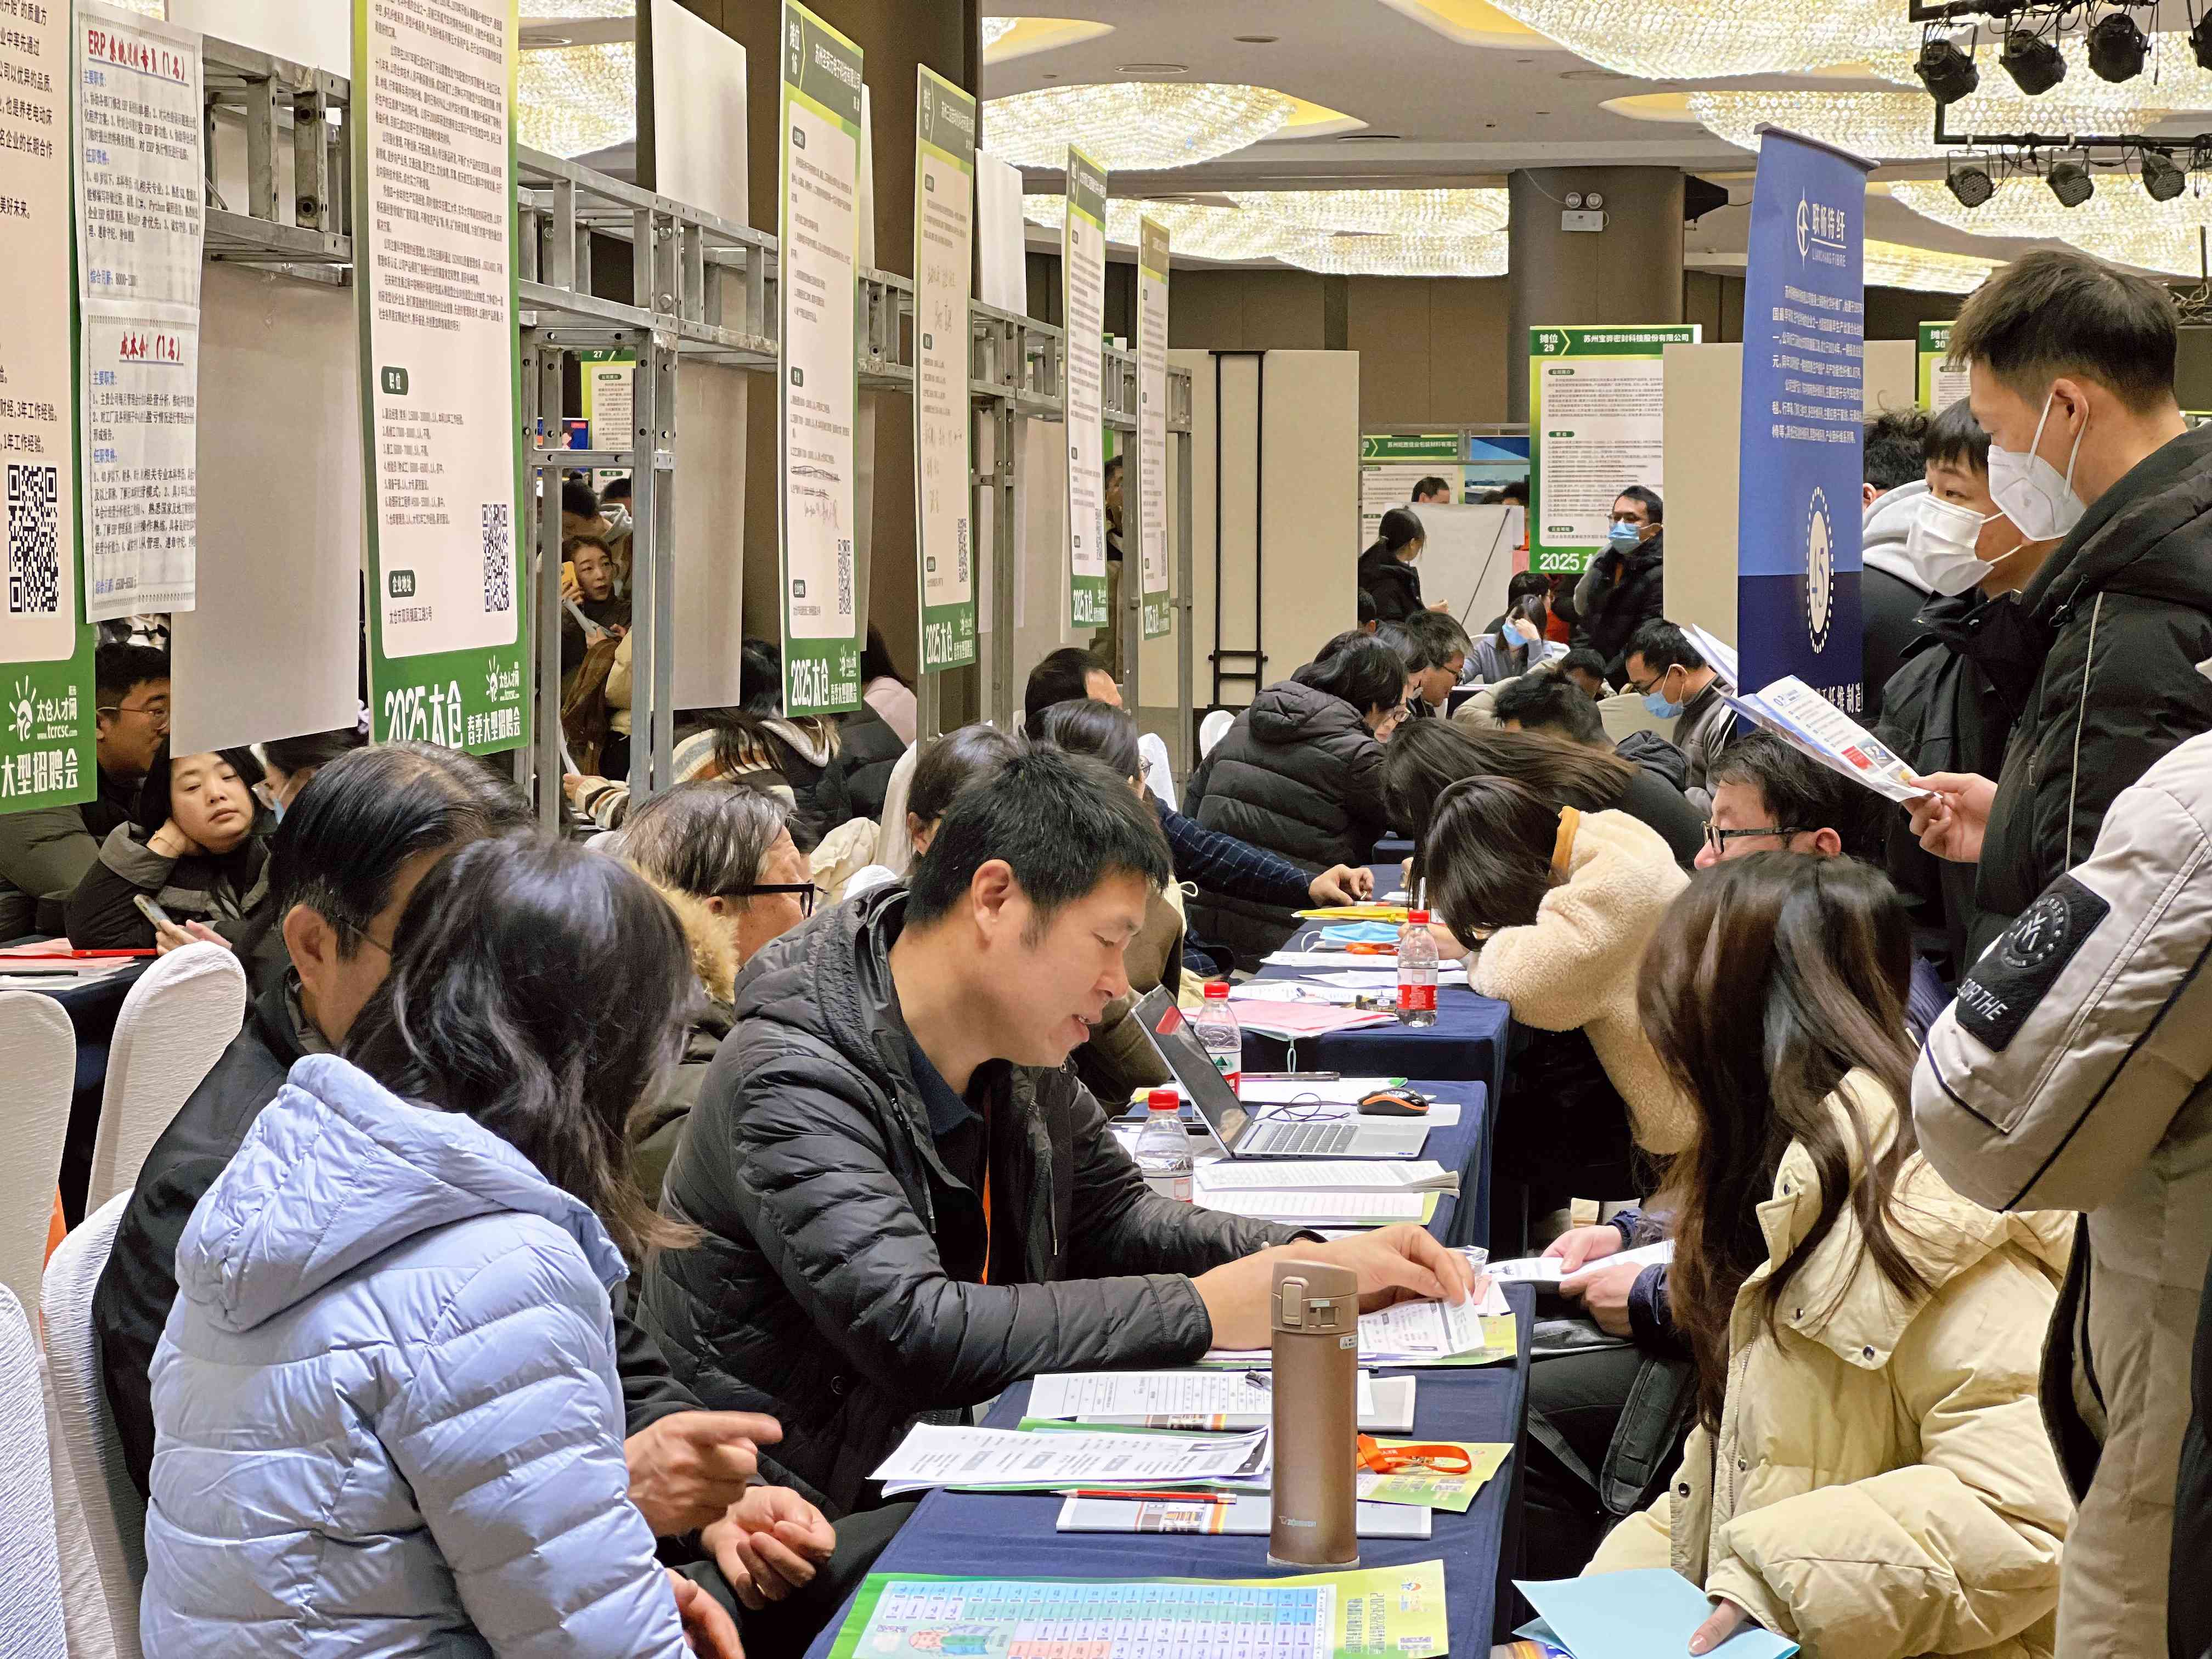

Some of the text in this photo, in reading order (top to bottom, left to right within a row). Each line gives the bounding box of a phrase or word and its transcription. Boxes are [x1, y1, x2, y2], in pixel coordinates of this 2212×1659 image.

[88, 30, 106, 57] ERP
[1544, 344, 1555, 352] 29
[1934, 340, 1946, 348] 30
[791, 658, 830, 707] 2025太仓
[37, 698, 77, 724] 太仓人才网
[467, 706, 521, 746] 春季大型招聘会
[1, 748, 78, 798] 大型招聘会
